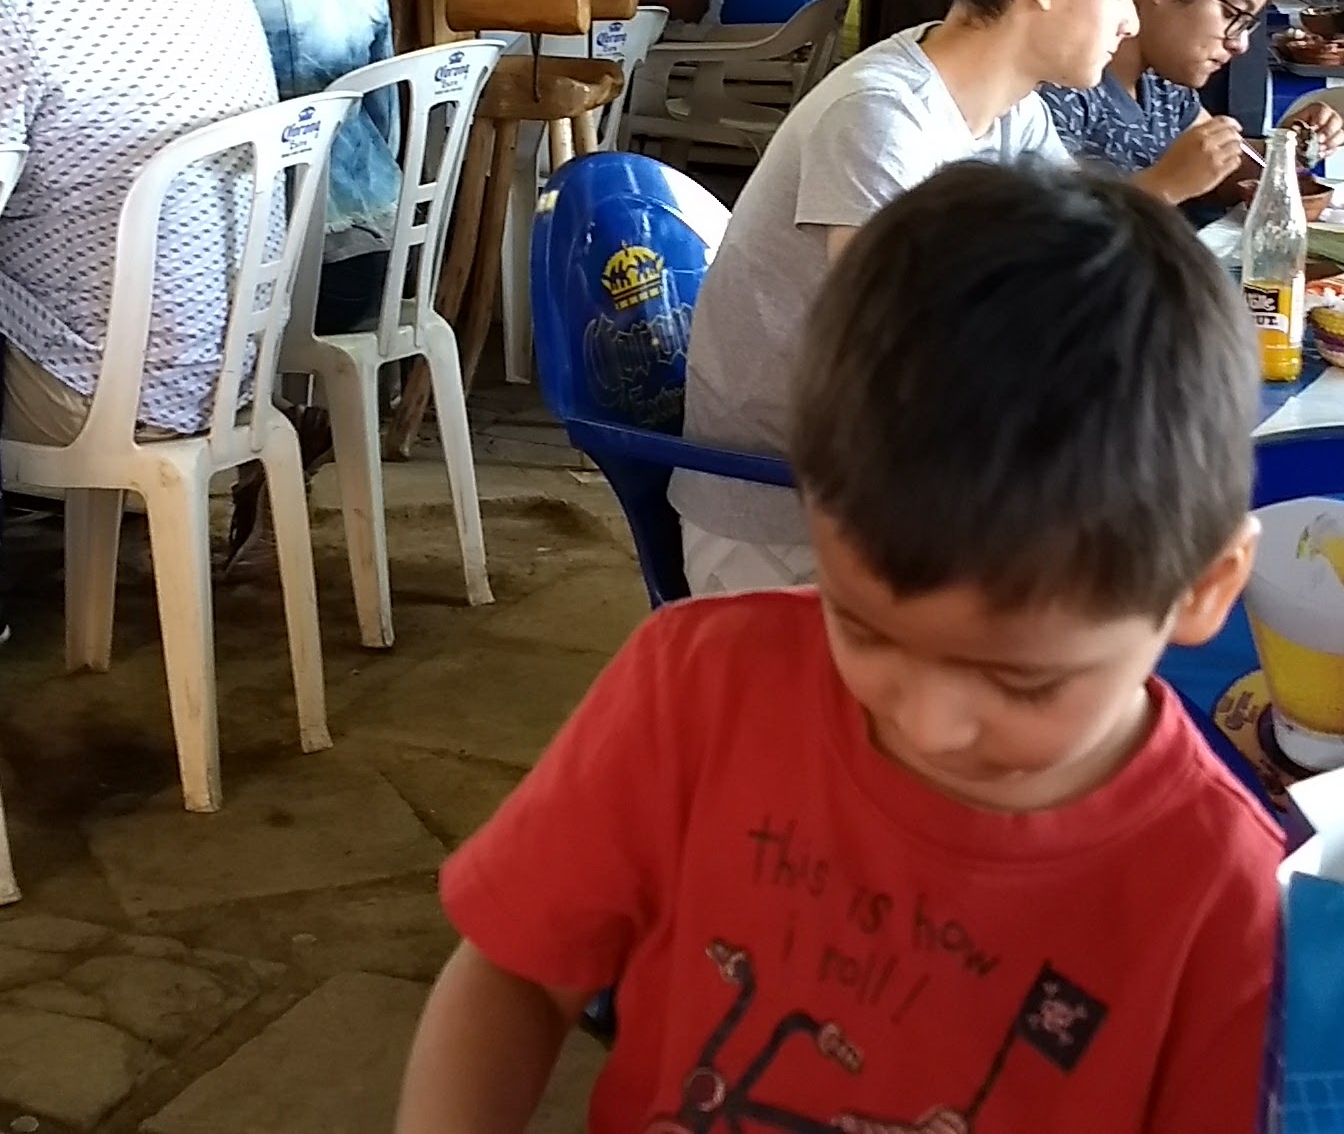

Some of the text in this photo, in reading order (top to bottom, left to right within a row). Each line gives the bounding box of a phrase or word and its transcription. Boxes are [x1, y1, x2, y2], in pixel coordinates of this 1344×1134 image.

[747, 814, 1001, 979] this is how
